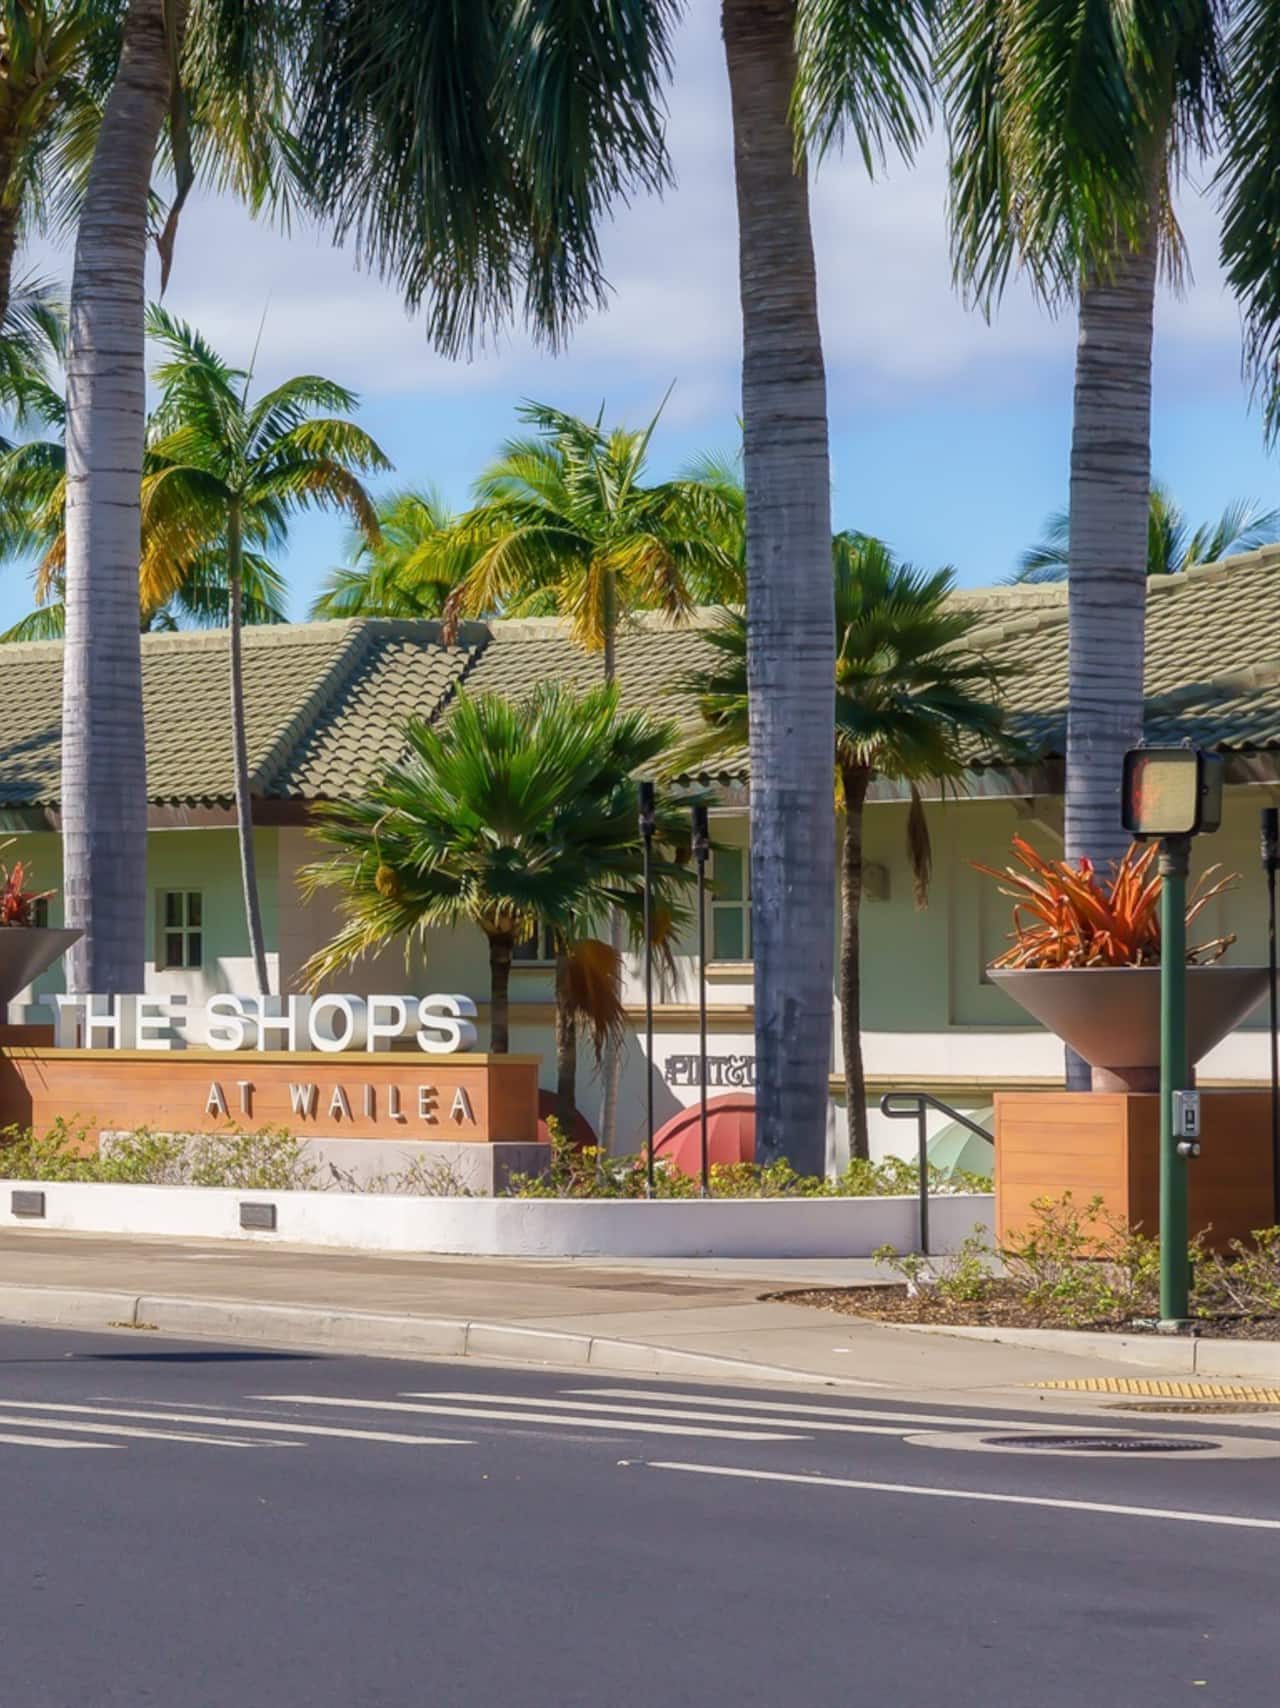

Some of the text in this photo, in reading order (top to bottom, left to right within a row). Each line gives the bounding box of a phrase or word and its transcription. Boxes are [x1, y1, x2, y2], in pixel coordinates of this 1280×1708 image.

[39, 993, 477, 1053] THE SHOPS
[205, 1081, 471, 1120] AT WAILEA
